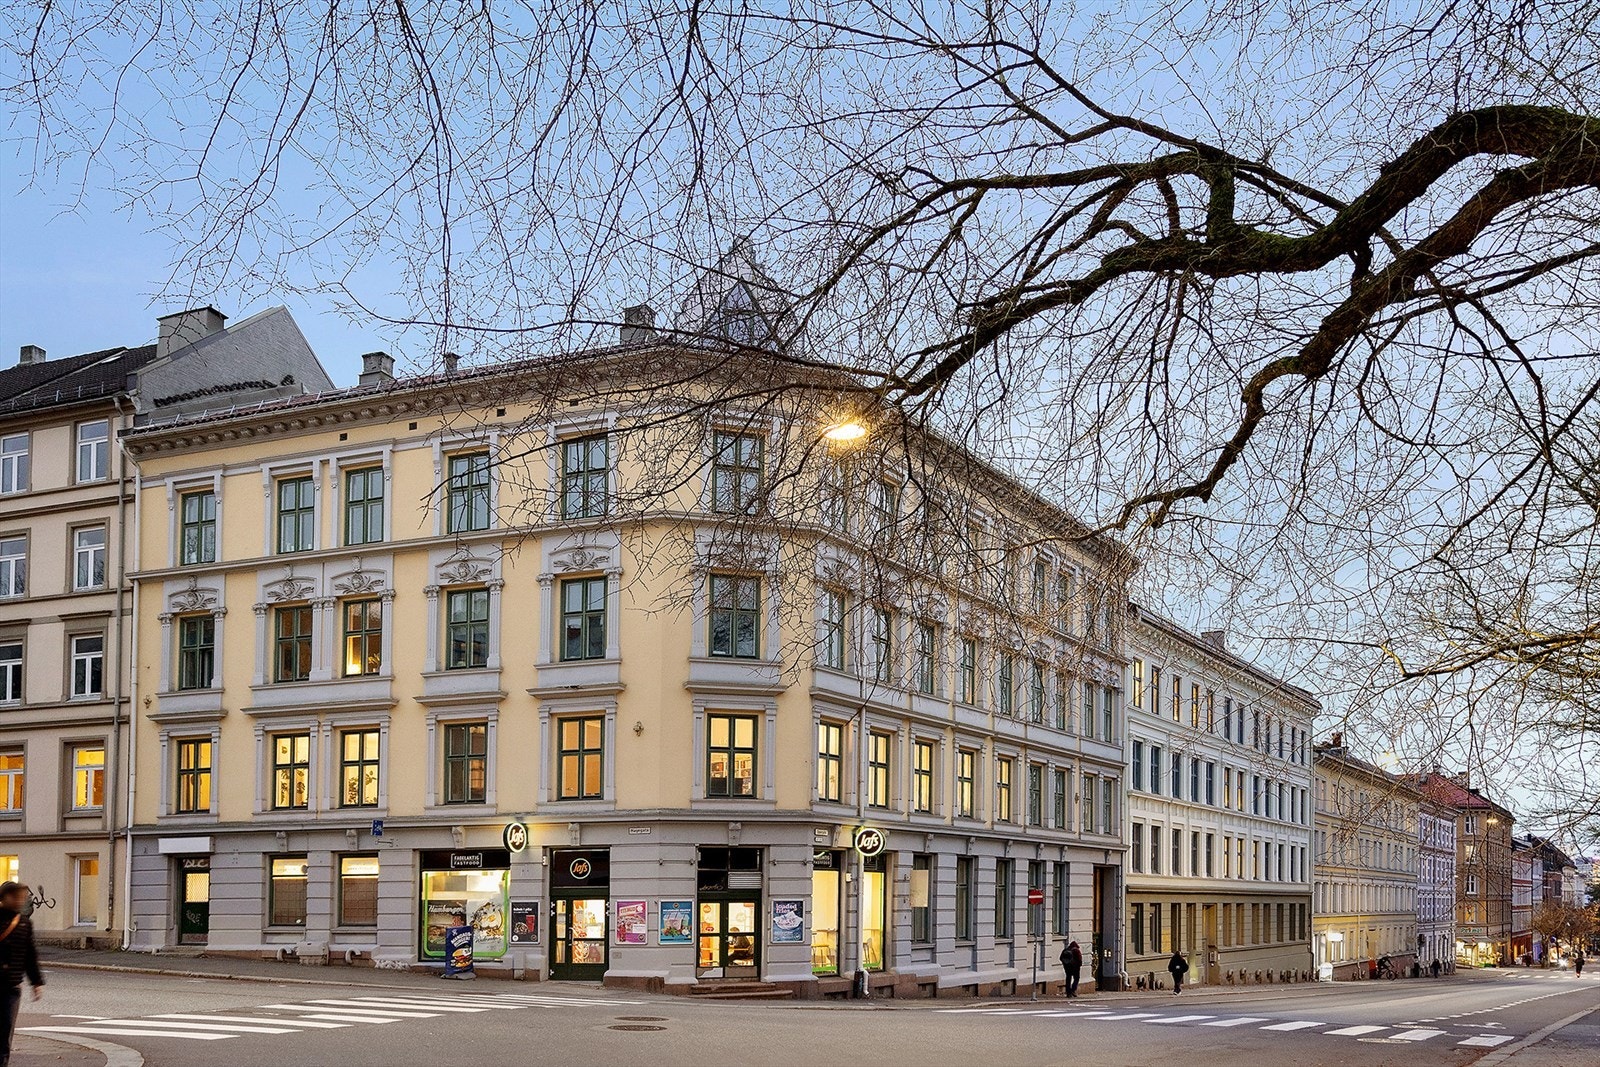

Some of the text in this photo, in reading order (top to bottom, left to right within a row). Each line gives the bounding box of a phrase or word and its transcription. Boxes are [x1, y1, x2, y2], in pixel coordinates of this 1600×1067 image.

[509, 828, 524, 846] Jafs
[859, 832, 879, 850] Jafs
[573, 862, 588, 874] Jafs
